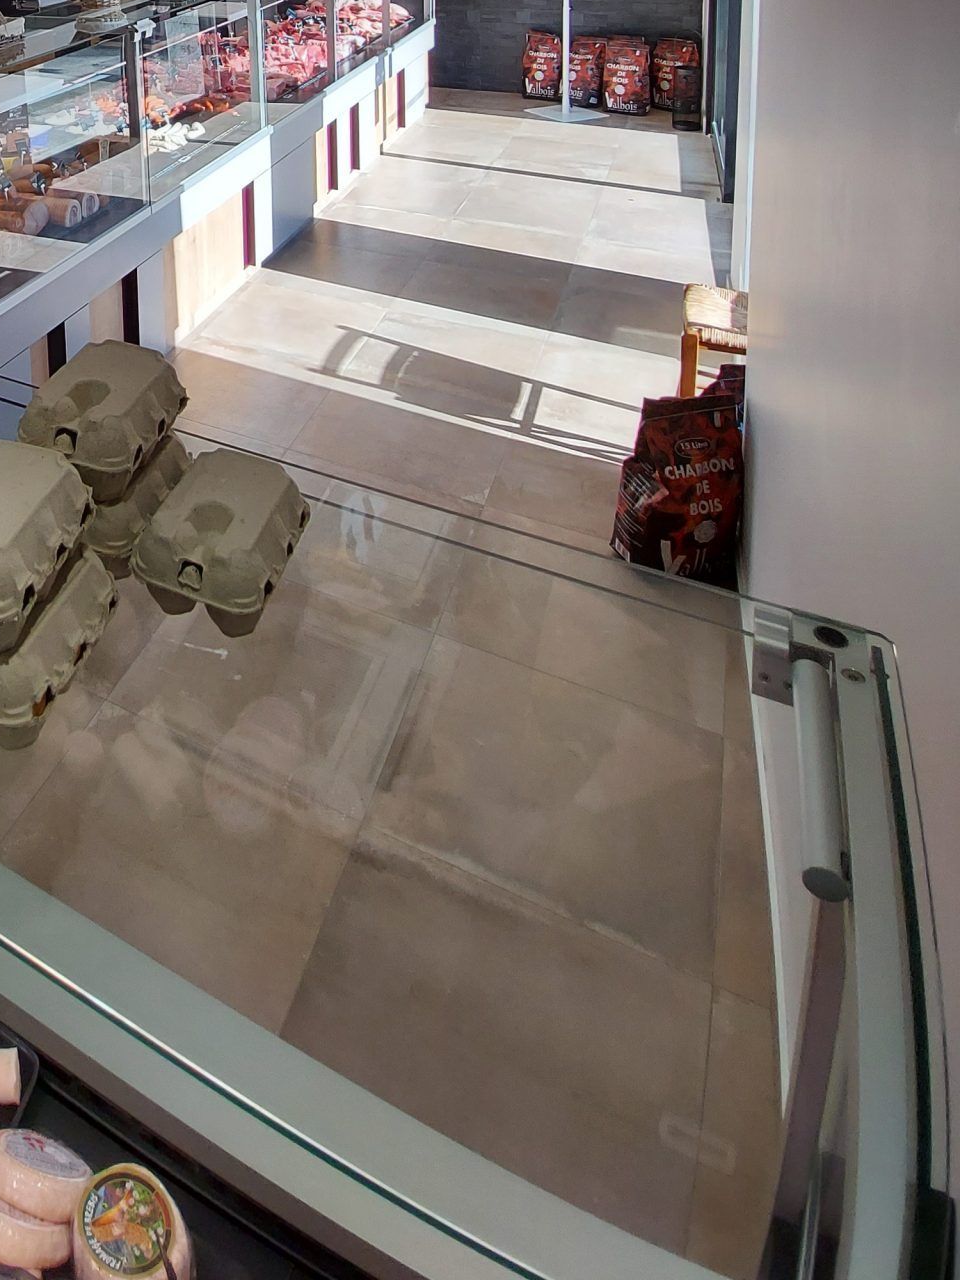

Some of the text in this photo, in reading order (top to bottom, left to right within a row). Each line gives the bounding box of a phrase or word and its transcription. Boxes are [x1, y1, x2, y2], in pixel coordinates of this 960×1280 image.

[664, 457, 735, 479] CHARBON
[696, 480, 711, 495] DE
[690, 498, 723, 516] BOIS
